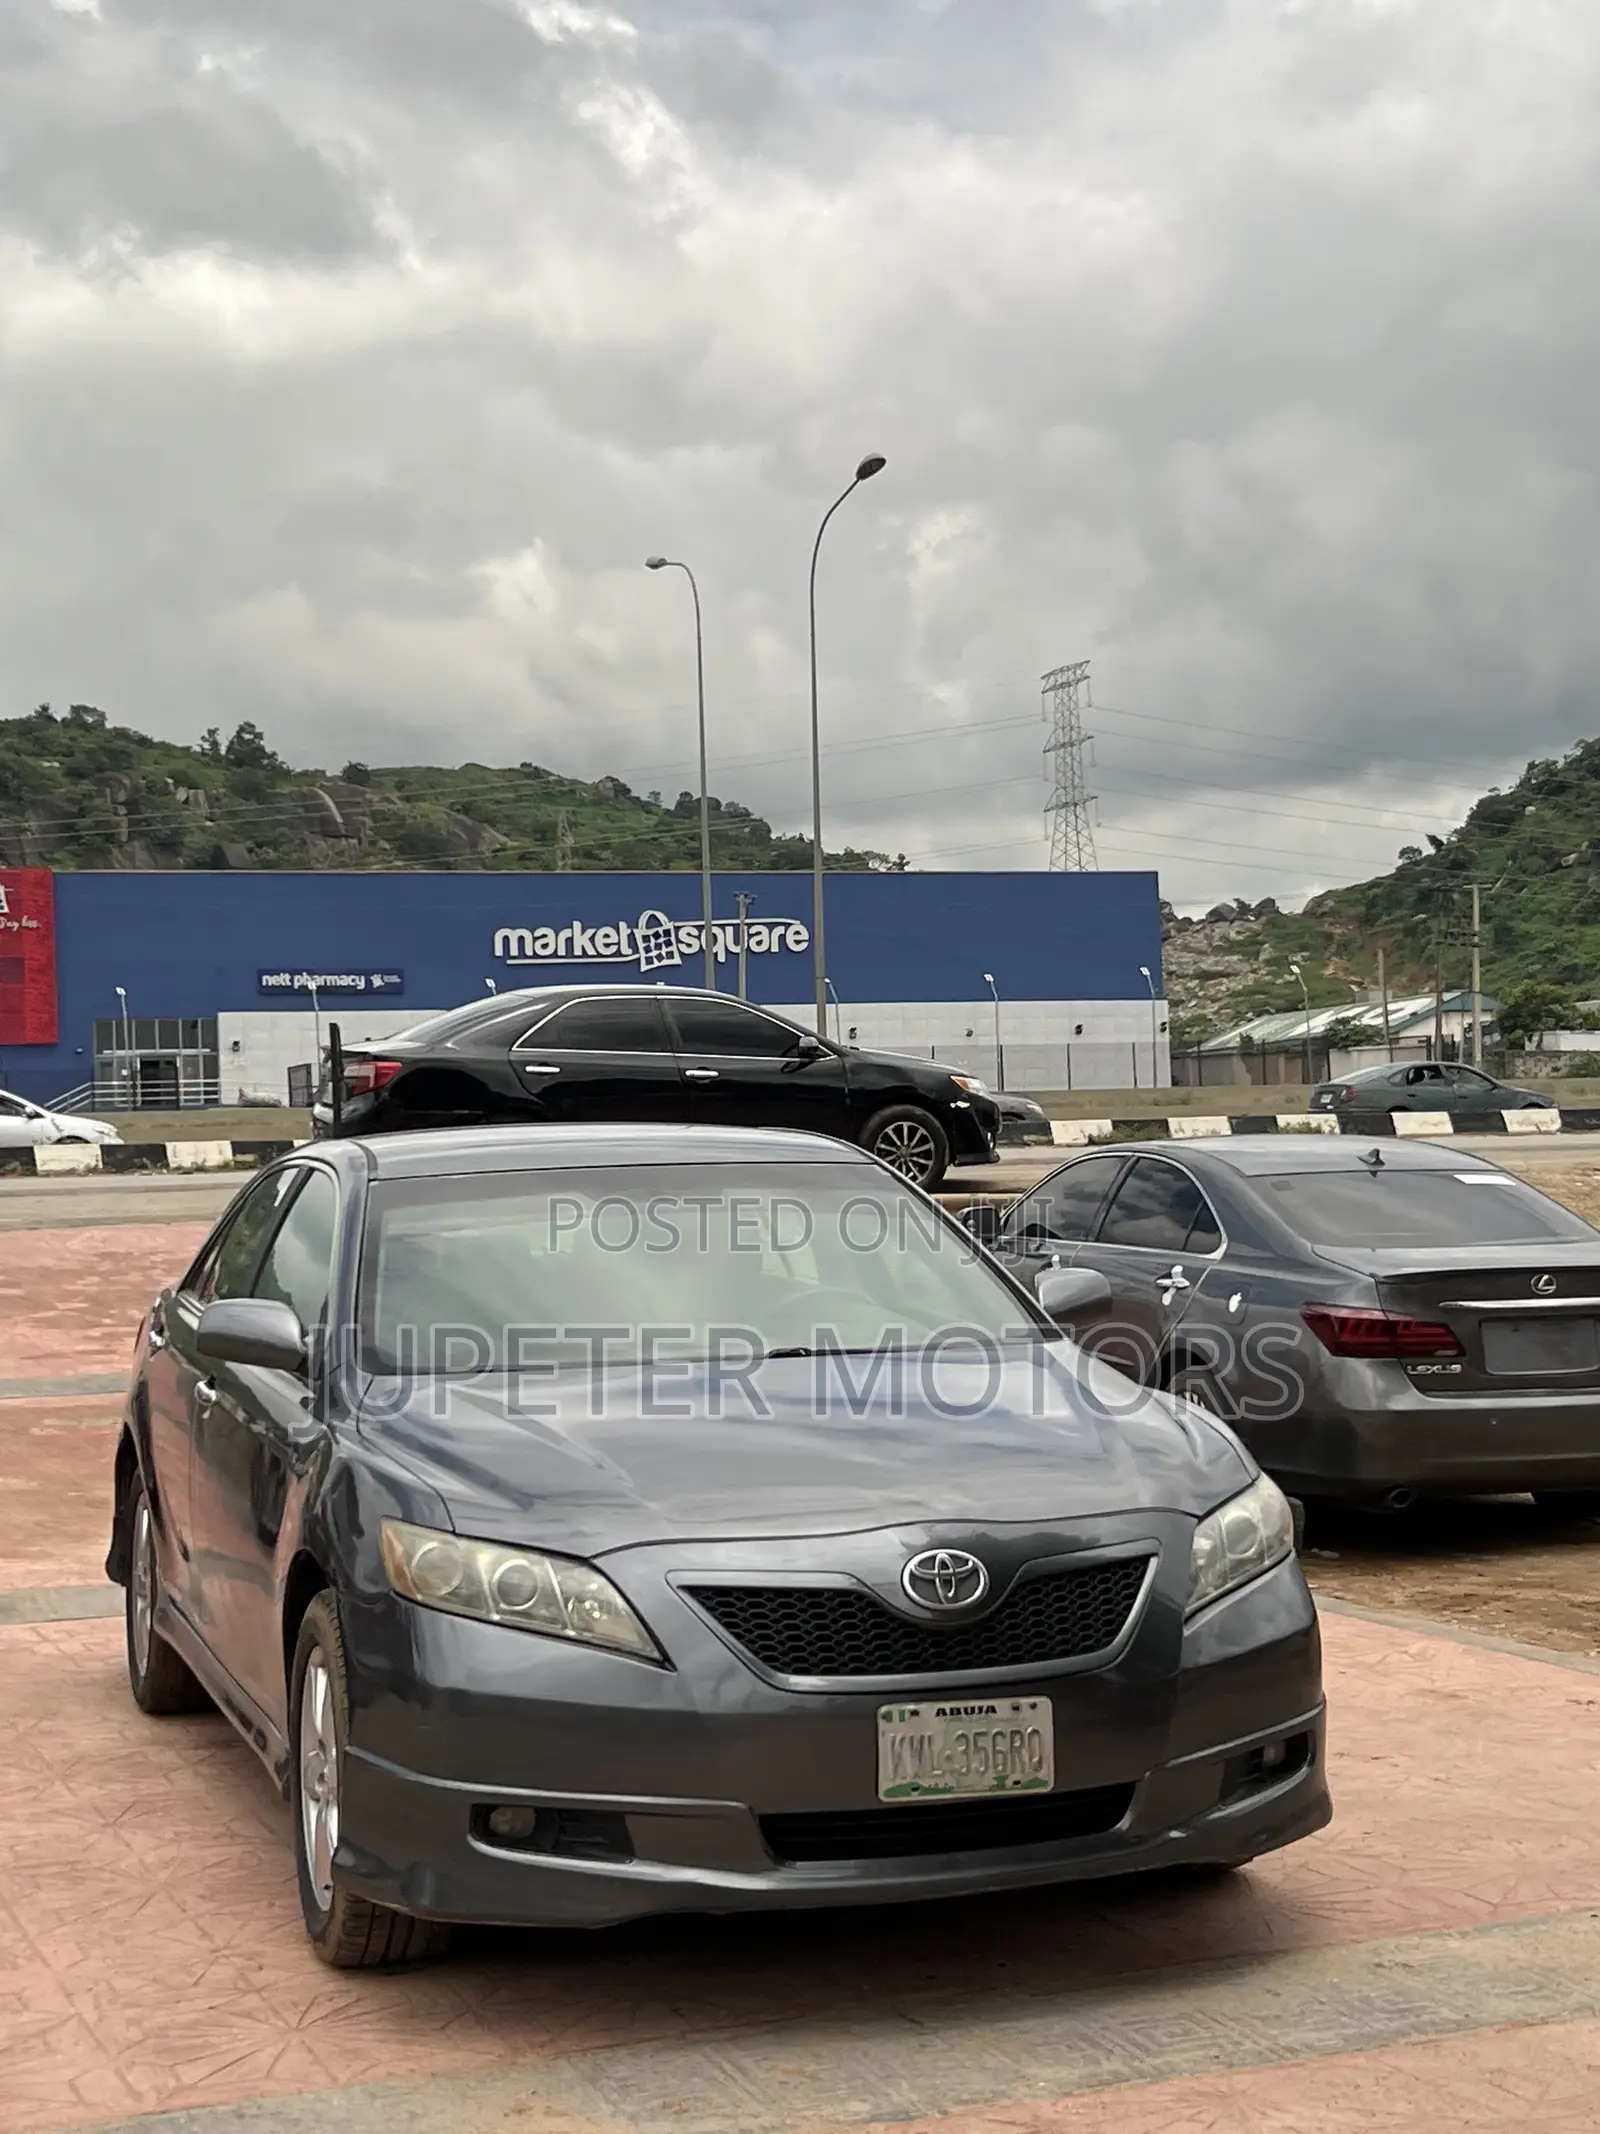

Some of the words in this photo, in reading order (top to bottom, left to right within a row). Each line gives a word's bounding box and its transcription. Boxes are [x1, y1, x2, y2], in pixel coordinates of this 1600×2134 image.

[494, 920, 633, 957] market
[677, 924, 810, 963] square
[294, 972, 366, 990] pharmacy
[1406, 1363, 1462, 1375] LEXUS
[935, 1704, 998, 1718] ABUJA
